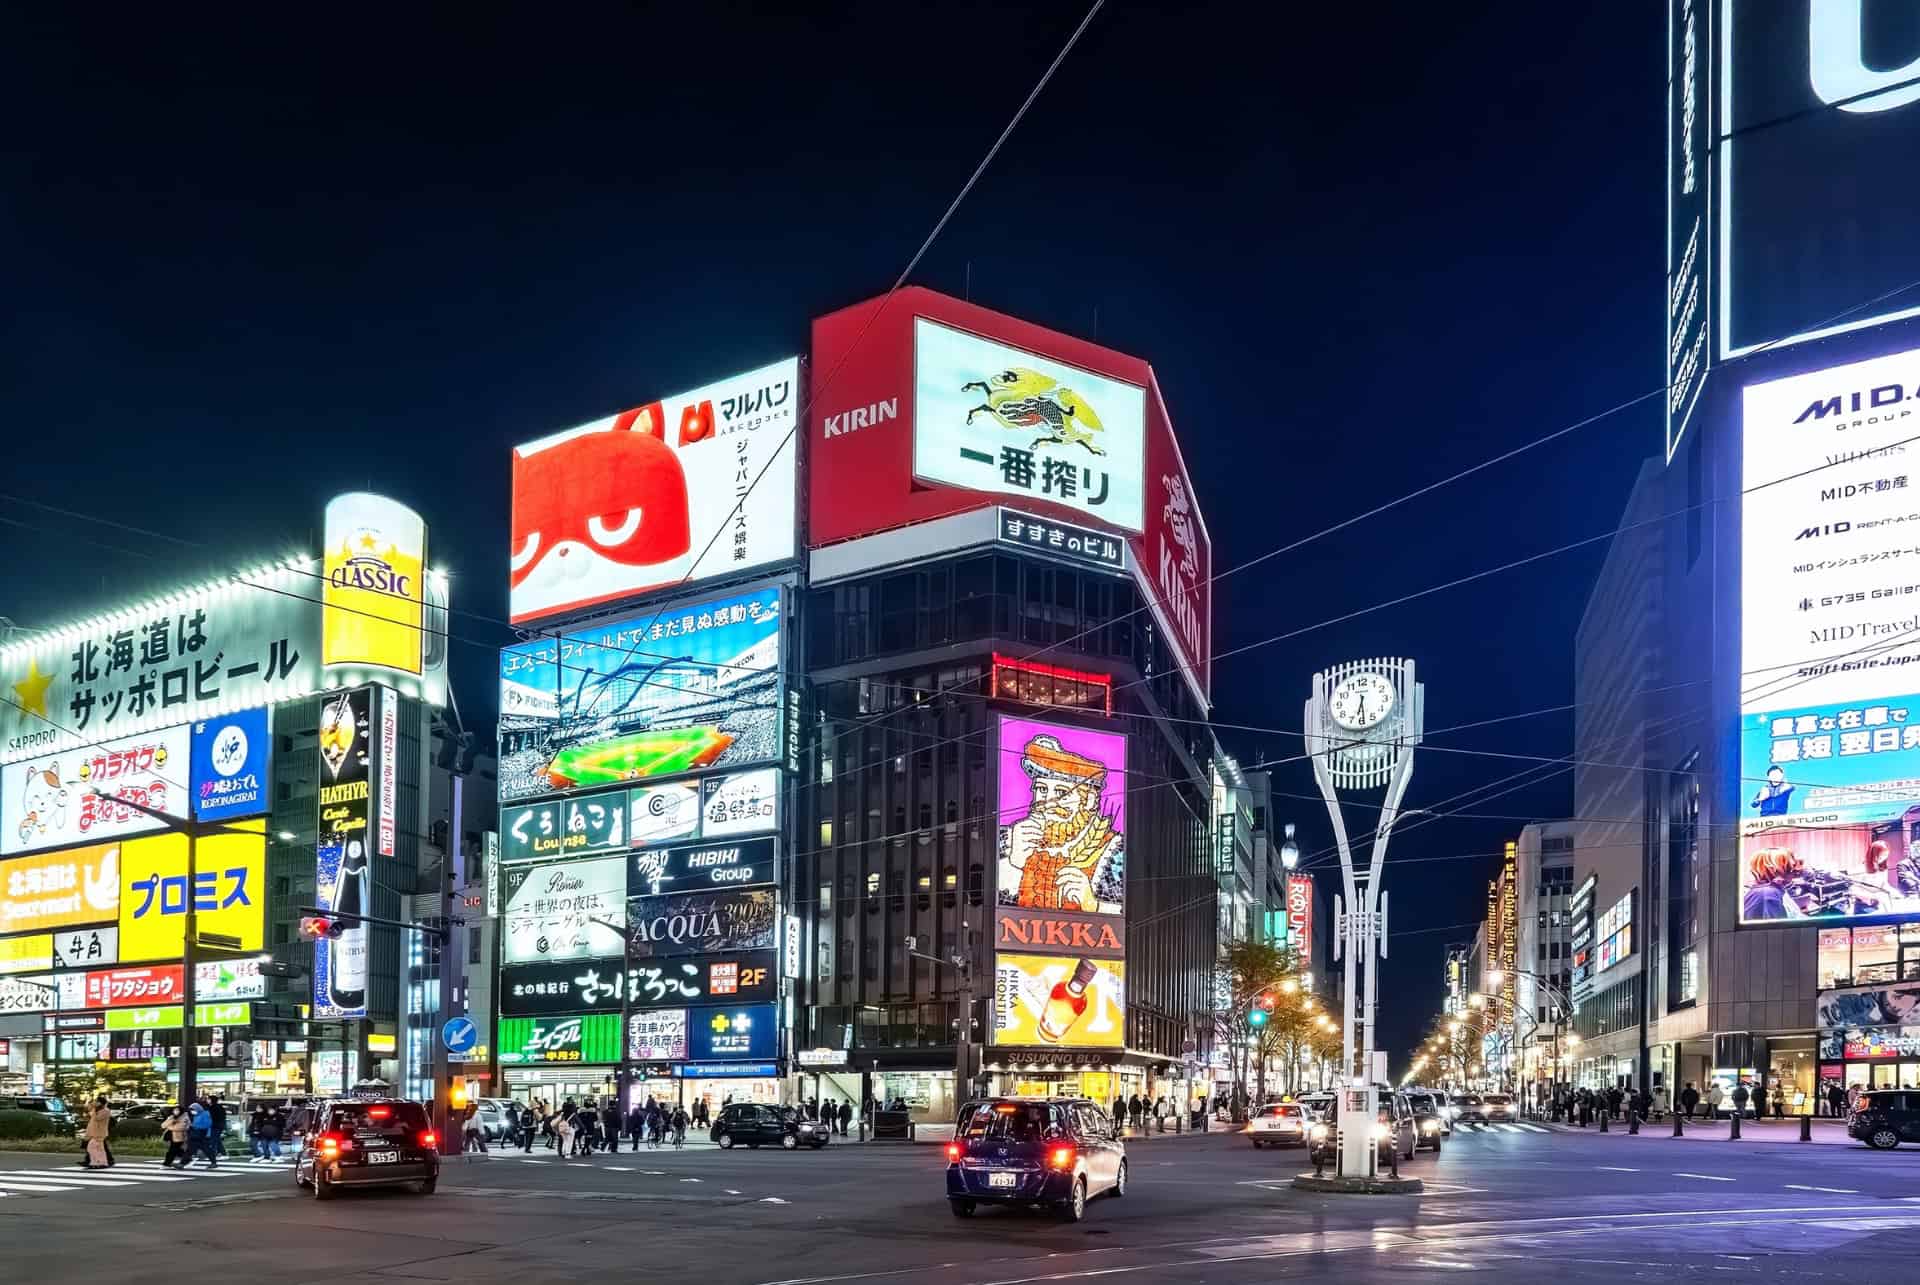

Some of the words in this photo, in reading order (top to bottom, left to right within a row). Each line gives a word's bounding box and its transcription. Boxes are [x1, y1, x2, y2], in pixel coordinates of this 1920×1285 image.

[721, 381, 788, 421] マルハン
[1792, 383, 1920, 425] MID.
[824, 398, 898, 439] KIRIN
[1836, 411, 1912, 431] GROUP
[960, 446, 1109, 506] 一番搾り
[1820, 475, 1909, 502] MID不動産
[735, 439, 748, 561] ジャパニーズ娯楽
[1006, 518, 1117, 561] すすきのビル
[1795, 521, 1851, 541] MID
[1857, 513, 1920, 529] RENT-A-C
[331, 567, 411, 597] CLASSIC
[1160, 531, 1201, 666] KIRIN
[71, 608, 207, 685] 北海道は
[69, 638, 300, 731] サッポロビール
[1347, 682, 1355, 691] 11
[1356, 678, 1367, 687] 12
[1371, 680, 1376, 688] 1
[1378, 685, 1385, 693] 2
[1336, 701, 1343, 710] 9
[1339, 691, 1349, 700] 10
[1382, 694, 1389, 703] 3
[1339, 710, 1346, 719] 8
[1349, 716, 1355, 724] 7
[1358, 717, 1365, 726] 6
[1369, 712, 1376, 721] 5
[8, 730, 56, 752] SAPPORO
[1769, 735, 1833, 763] 最短
[92, 747, 155, 779] カラオケ
[320, 781, 369, 805] HATHYR
[511, 803, 605, 844] くろねこ
[1787, 814, 1838, 826] STUDIO
[534, 834, 586, 851] Lounge
[688, 848, 740, 868] HIBIKI
[509, 872, 524, 887] 9F
[711, 868, 753, 882] Group
[131, 867, 251, 919] プロミス
[632, 912, 721, 944] ACQUA
[1001, 917, 1122, 950] NIKKA
[69, 931, 103, 960] 牛角
[112, 976, 174, 998] ワタショウ
[512, 982, 569, 995] 北の味紀行
[574, 964, 701, 1004] さっぽろっこ
[740, 967, 768, 987] 2F
[1009, 970, 1019, 1009] NIKKA
[997, 968, 1007, 1029] FRONTIER
[522, 1019, 582, 1051] エイブル
[1007, 1052, 1073, 1064] SUSUKINO
[1076, 1054, 1104, 1065] BLD.
